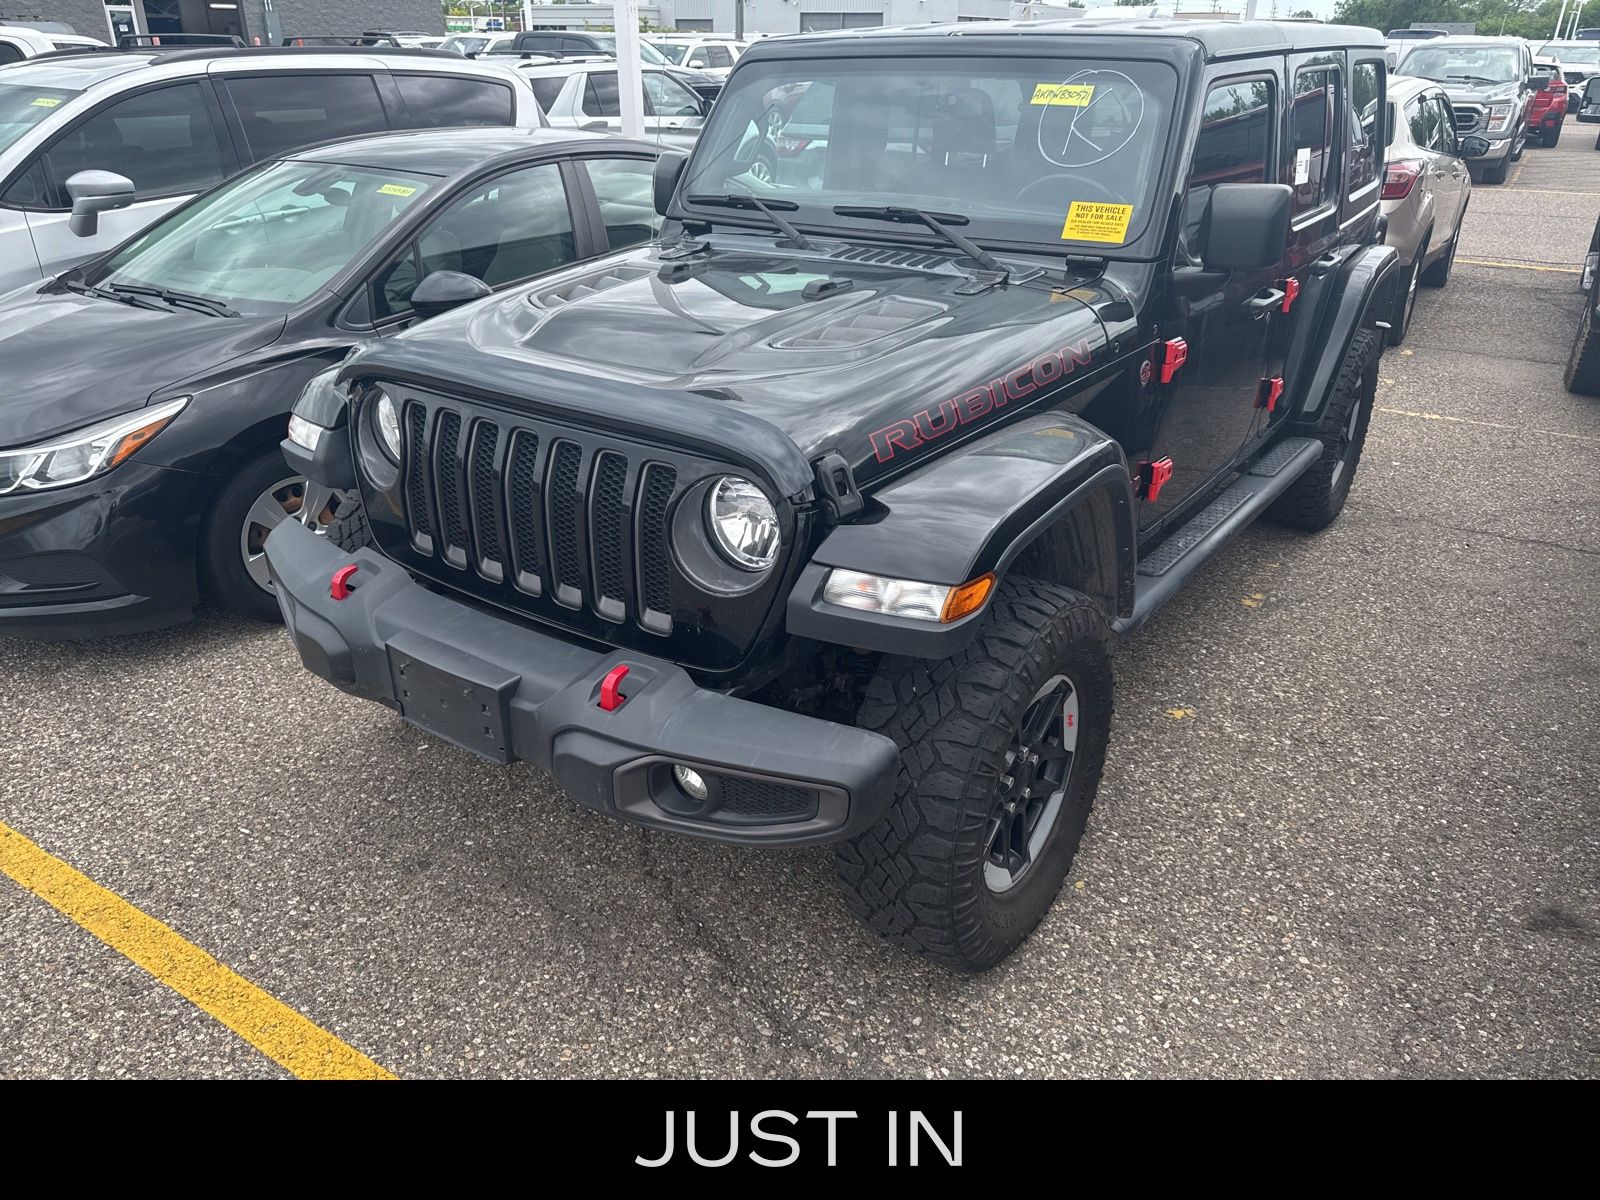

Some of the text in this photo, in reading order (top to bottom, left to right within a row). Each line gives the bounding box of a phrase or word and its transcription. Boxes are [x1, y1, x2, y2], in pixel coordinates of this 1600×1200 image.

[1062, 81, 1112, 156] K
[1075, 212, 1089, 220] NOT
[1105, 214, 1124, 222] SALE
[1076, 204, 1127, 215] THIS VEHICLE
[868, 337, 1092, 464] RUBICON
